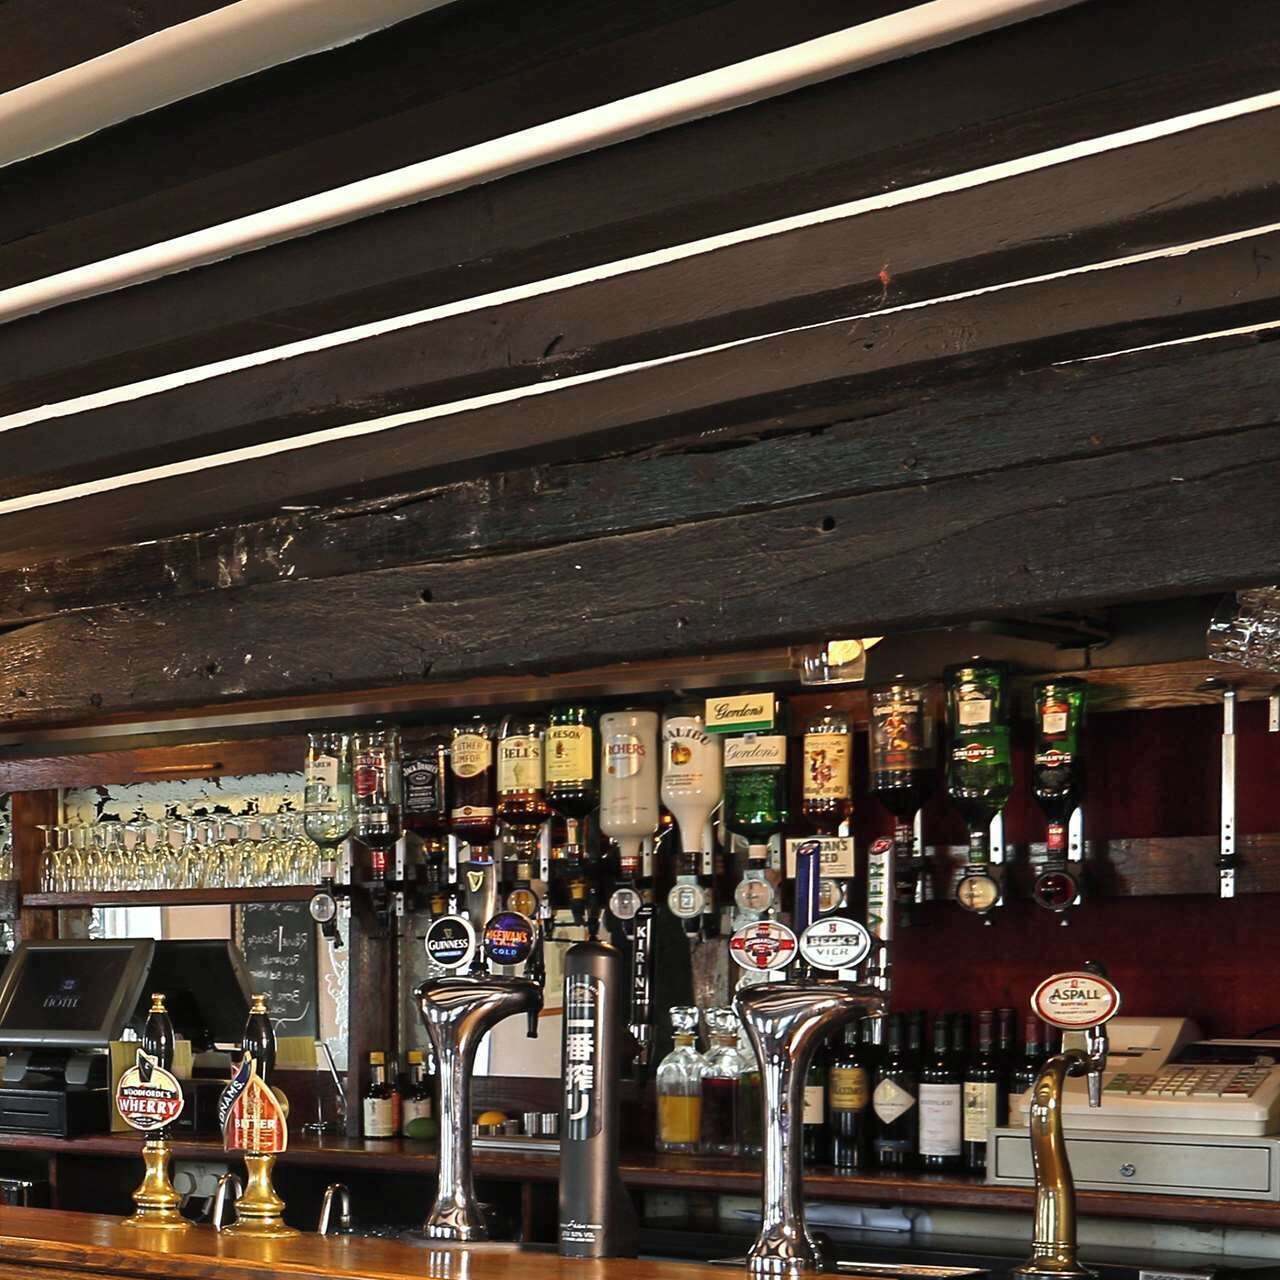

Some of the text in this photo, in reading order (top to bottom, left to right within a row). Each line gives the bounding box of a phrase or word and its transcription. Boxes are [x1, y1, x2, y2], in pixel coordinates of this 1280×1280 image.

[792, 841, 848, 852] MGAN'S
[868, 861, 884, 926] VIER
[428, 938, 469, 951] GUINNESS
[492, 947, 517, 956] COLD
[634, 926, 647, 988] KIRIN
[816, 948, 850, 956] VIER
[1049, 988, 1100, 1003] ASPALL
[566, 1018, 595, 1121] 一番搾り
[119, 1099, 178, 1115] WHERRY
[235, 1118, 276, 1129] BITTER
